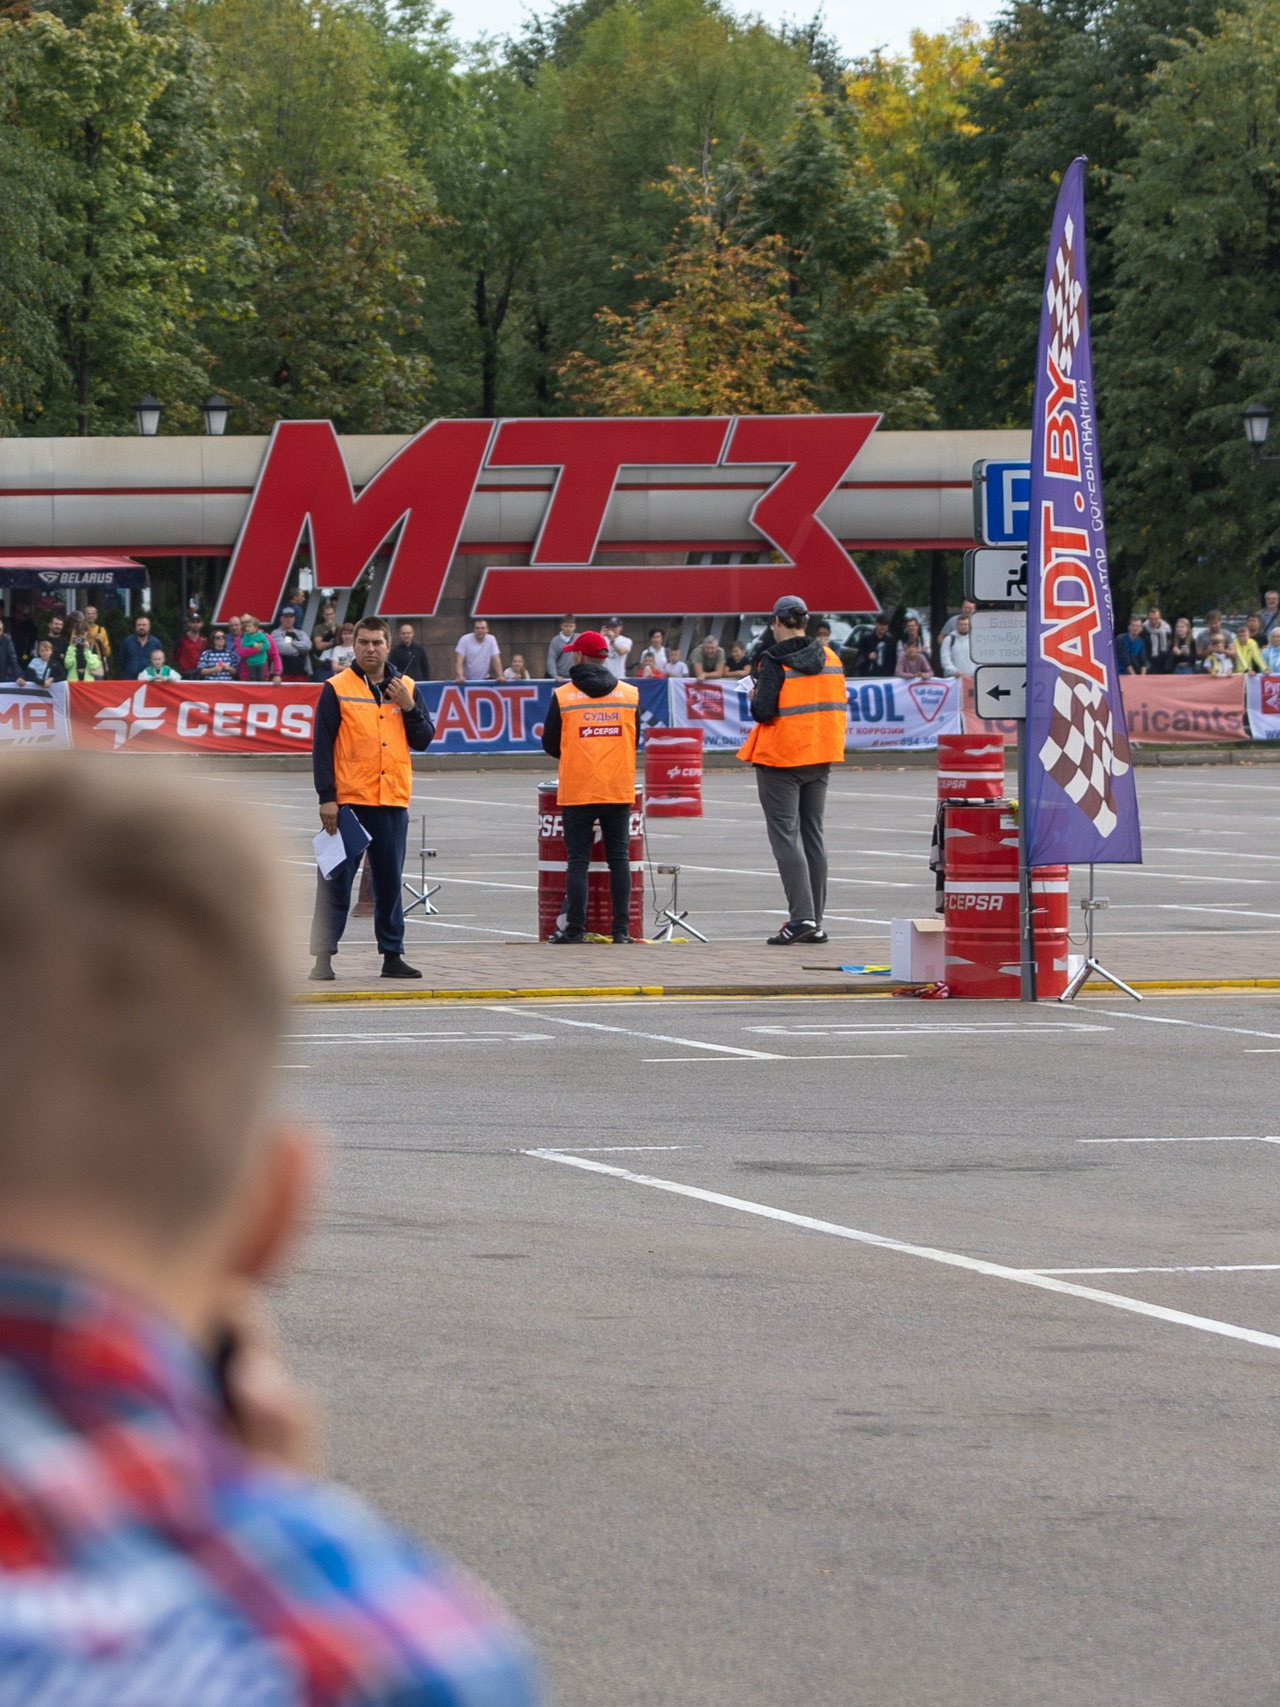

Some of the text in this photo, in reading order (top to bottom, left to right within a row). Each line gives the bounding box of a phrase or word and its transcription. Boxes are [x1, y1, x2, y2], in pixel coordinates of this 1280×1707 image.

[211, 412, 884, 625] МТЗ
[1039, 352, 1109, 692] ADT.BY
[58, 571, 114, 585] BELARUS
[989, 617, 1026, 629] Благо
[176, 701, 314, 739] CEPS
[431, 685, 545, 745] ADT.
[583, 711, 619, 722] СУДЬЯ
[1127, 703, 1241, 733] ricants
[593, 727, 620, 735] CEPSA
[856, 727, 905, 735] КОРРОЗИИ
[938, 779, 967, 789] CEPSA
[948, 895, 1004, 911] CEPSA
